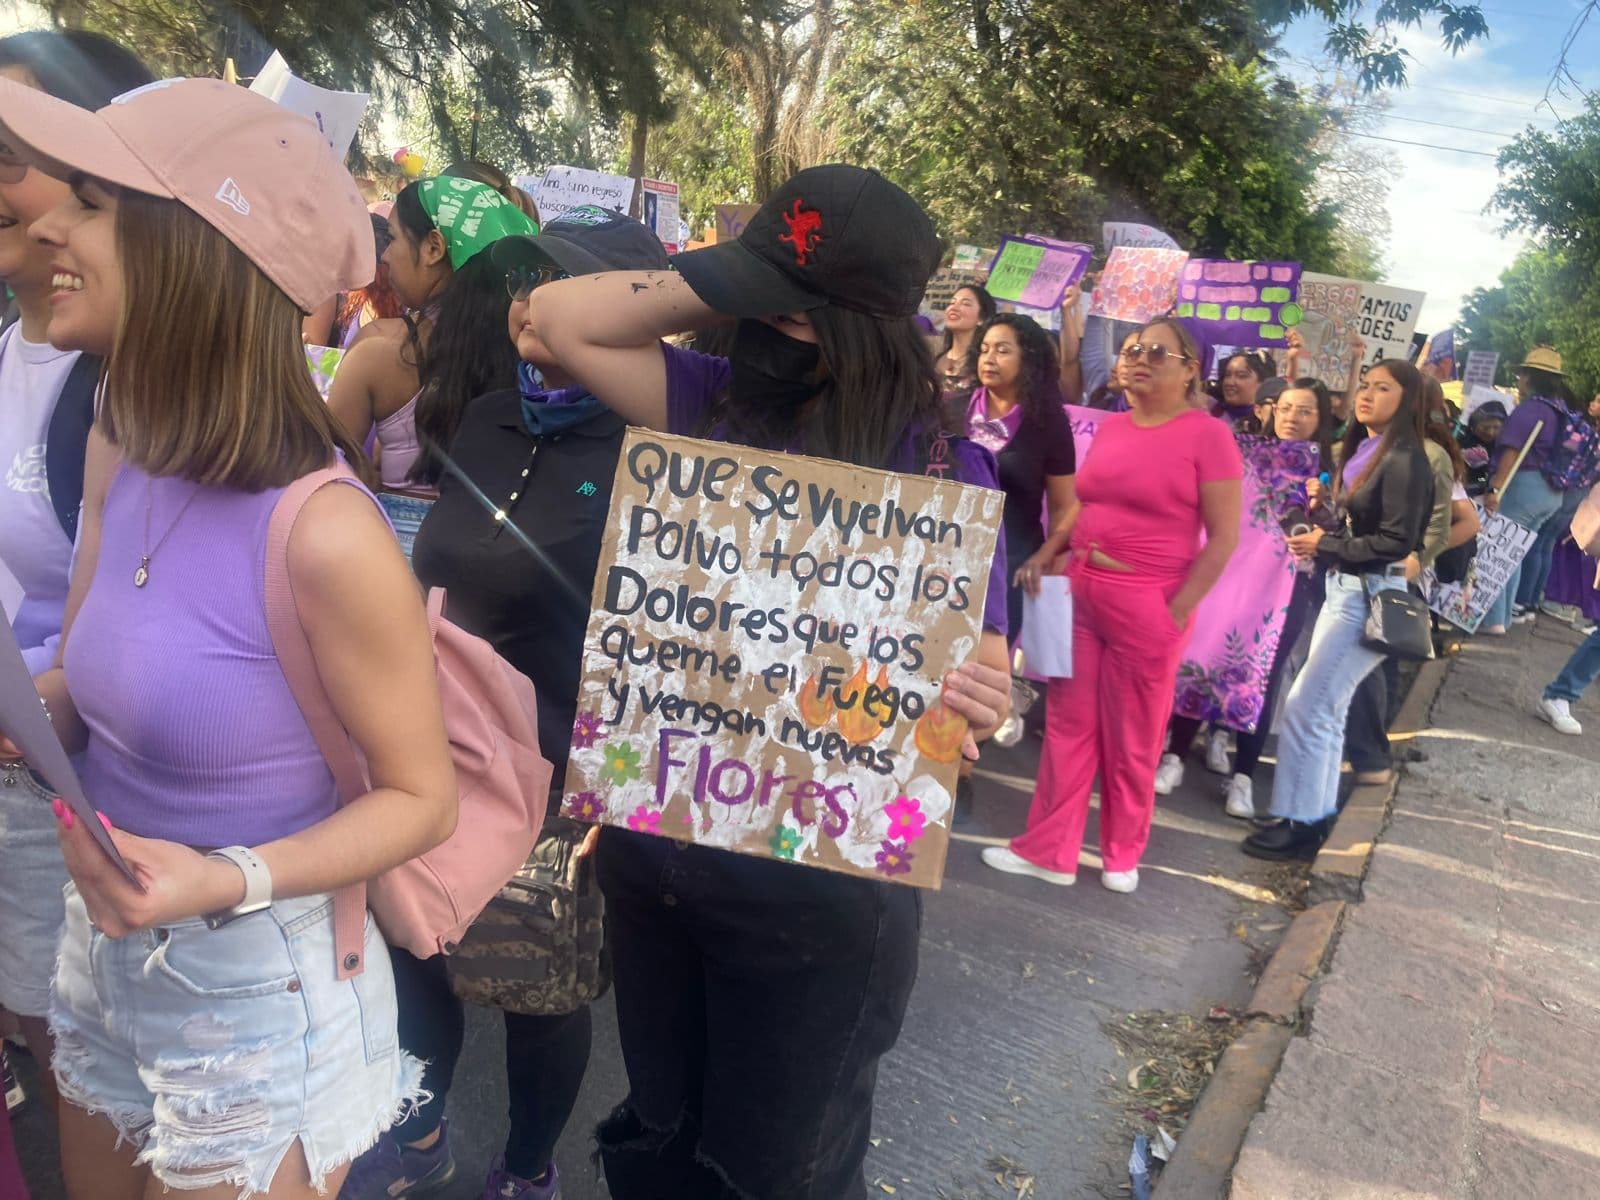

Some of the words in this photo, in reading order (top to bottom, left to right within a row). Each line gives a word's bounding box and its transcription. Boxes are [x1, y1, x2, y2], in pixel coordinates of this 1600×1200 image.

[1300, 281, 1358, 303] ERGA
[1356, 316, 1405, 343] DES...
[1360, 295, 1412, 322] AMOS
[626, 505, 742, 575] Polvo
[759, 538, 900, 600] todos
[912, 566, 973, 612] los
[603, 564, 789, 643] Dolores
[793, 612, 859, 655] que
[868, 631, 925, 673] los
[600, 624, 741, 683] queme
[761, 661, 797, 694] el
[817, 665, 925, 729] Fuego
[606, 676, 631, 727] y
[639, 687, 767, 738] vengan
[780, 715, 896, 775] nuevas
[655, 727, 858, 839] Flores
